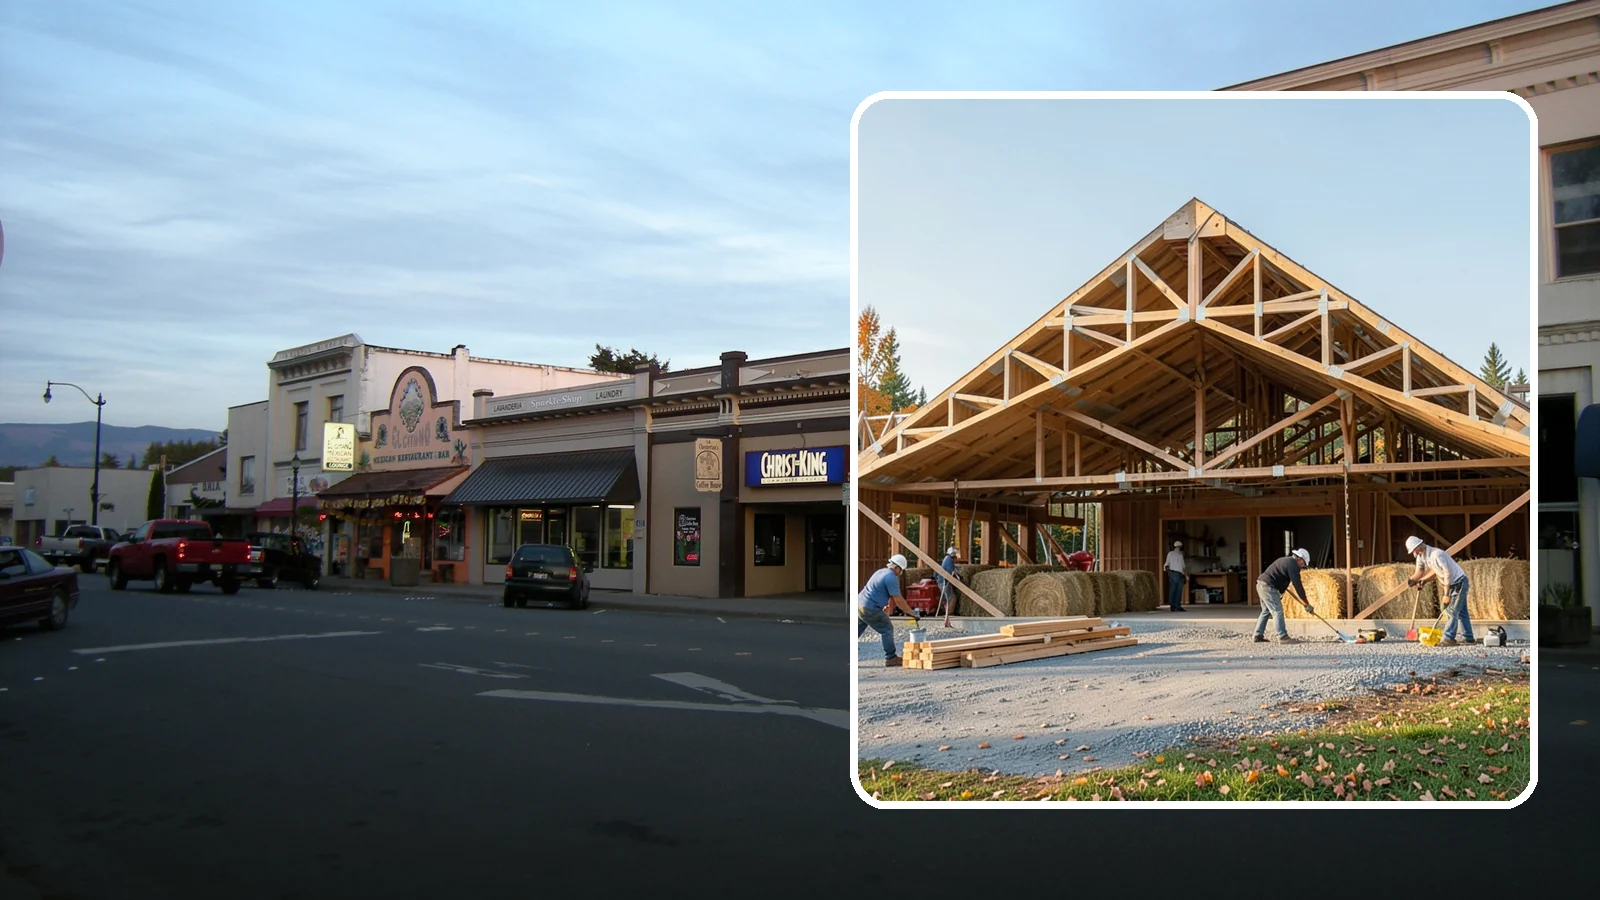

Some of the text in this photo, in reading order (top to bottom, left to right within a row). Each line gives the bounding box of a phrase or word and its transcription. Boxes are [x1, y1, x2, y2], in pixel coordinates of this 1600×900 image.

[562, 394, 582, 404] Shop
[596, 389, 623, 399] LAUNDRY
[493, 402, 522, 412] LAVANDERIA
[373, 455, 396, 464] MEXICAN
[397, 452, 433, 462] RESTAURANT
[437, 450, 450, 459] BAR
[761, 450, 827, 478] CHRIST KING
